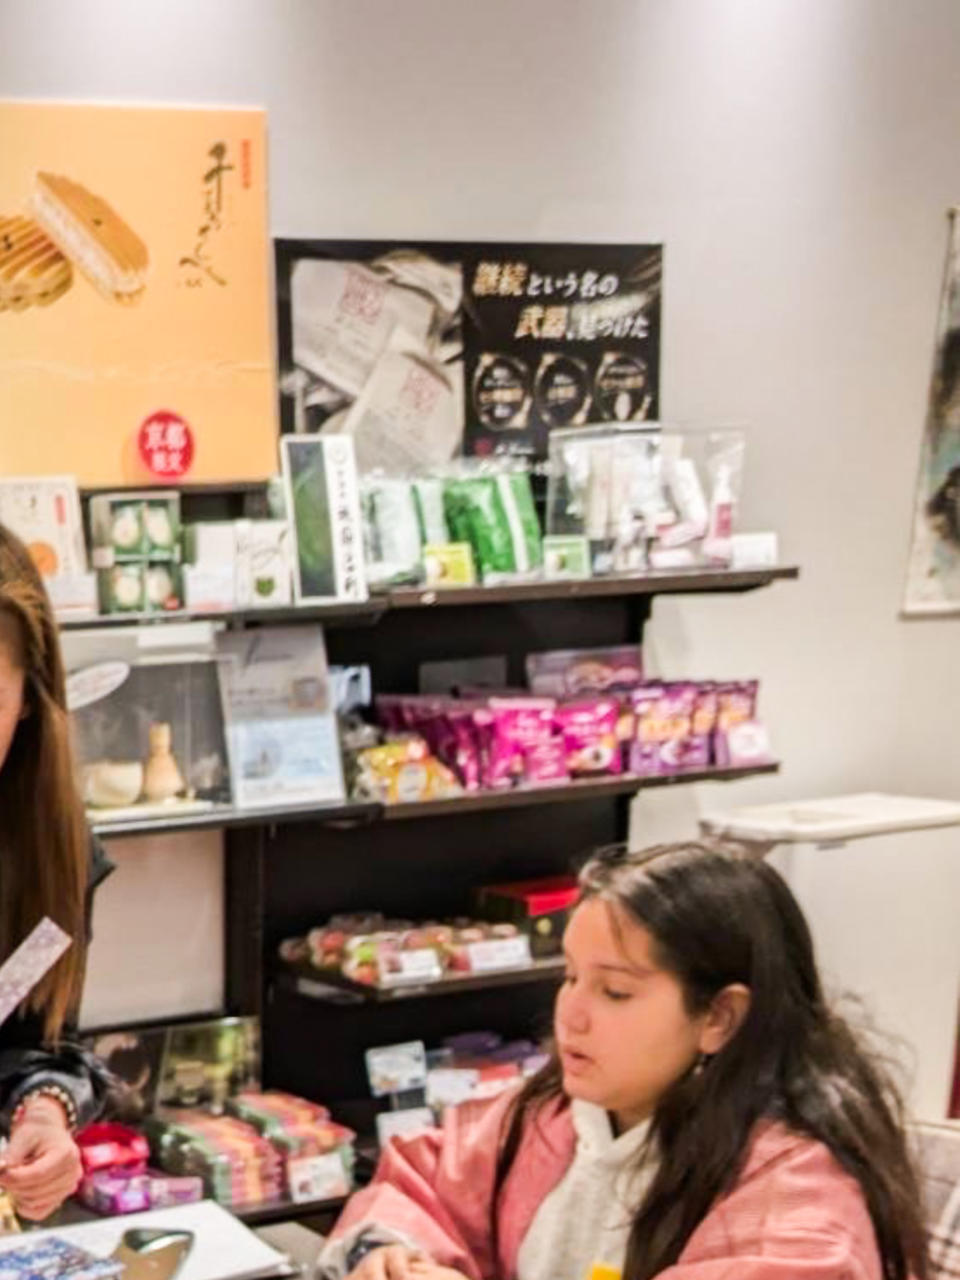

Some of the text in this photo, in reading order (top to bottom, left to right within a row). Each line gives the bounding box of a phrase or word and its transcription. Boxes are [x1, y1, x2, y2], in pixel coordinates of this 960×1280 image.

[472, 261, 619, 298] 継続という名の
[145, 421, 188, 450] 京都
